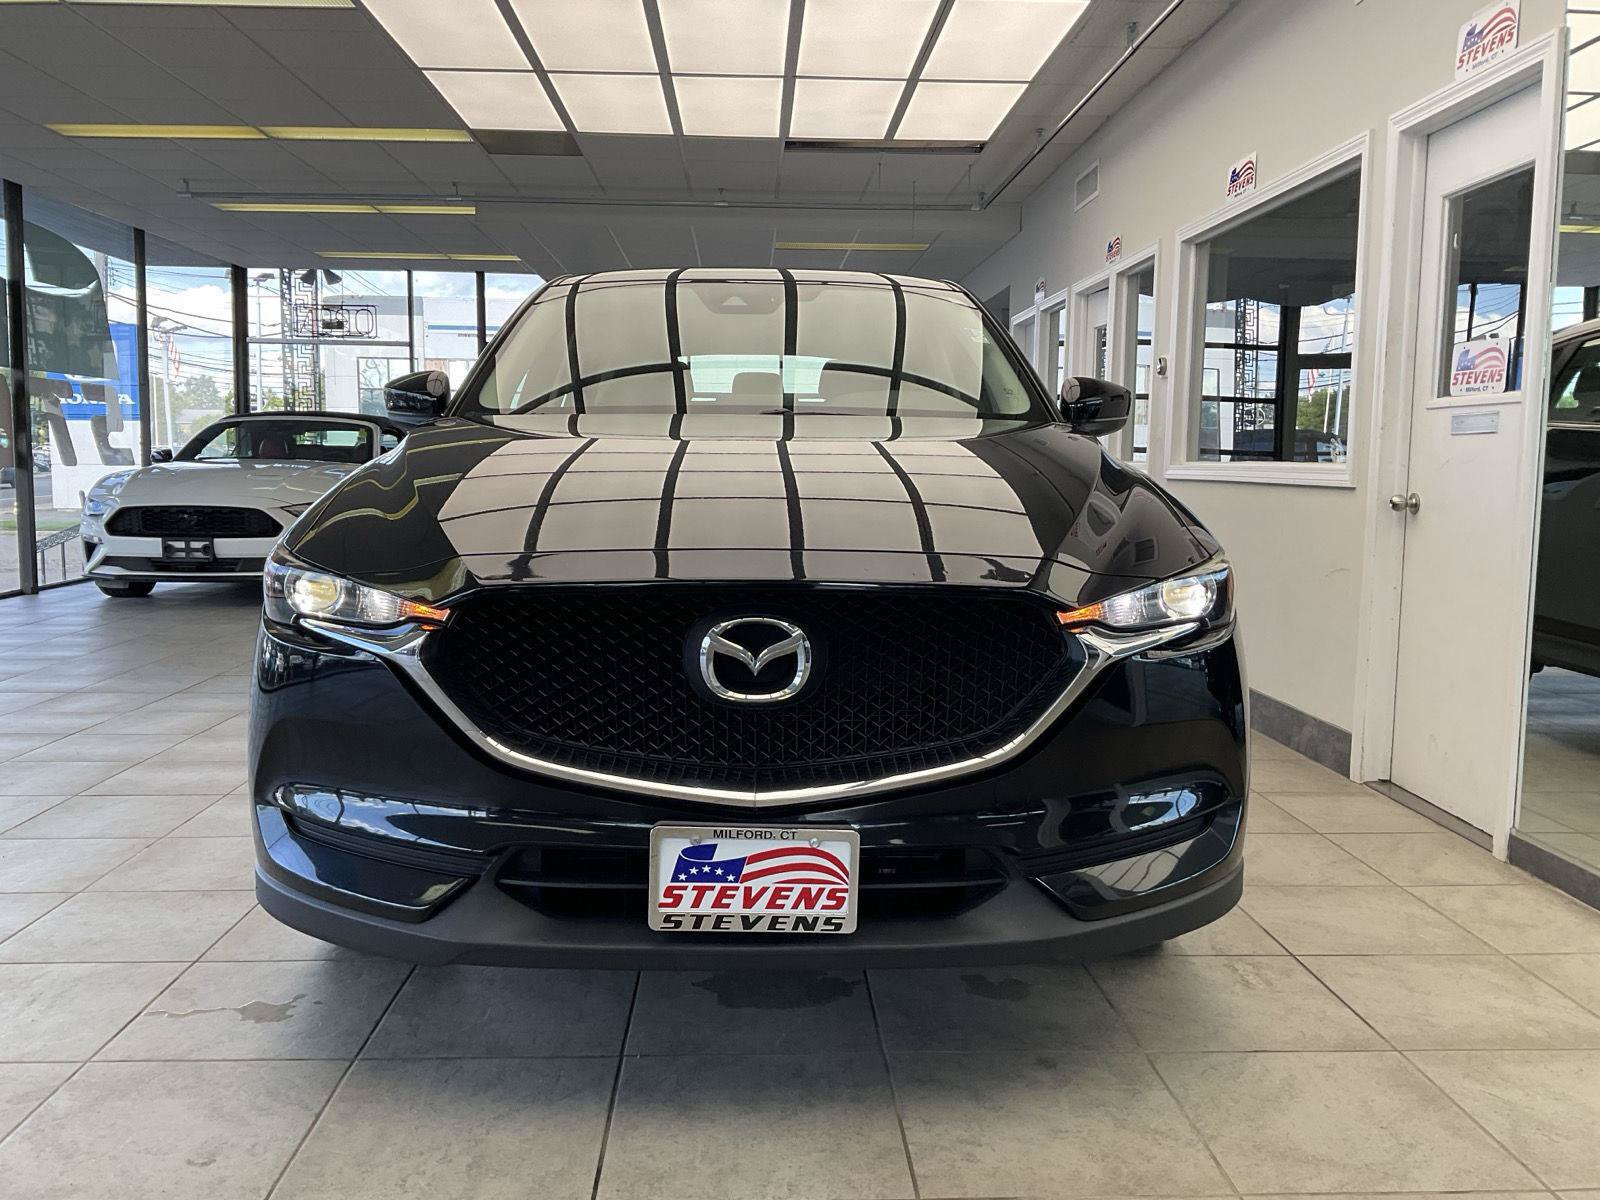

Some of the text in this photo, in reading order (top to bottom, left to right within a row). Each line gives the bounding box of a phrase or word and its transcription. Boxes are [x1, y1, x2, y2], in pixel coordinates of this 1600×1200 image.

[1457, 25, 1515, 70] STEVENS
[1452, 368, 1505, 386] STEVENS
[780, 830, 798, 840] CT
[658, 885, 848, 910] STEVENS
[660, 914, 846, 932] STEVENS
